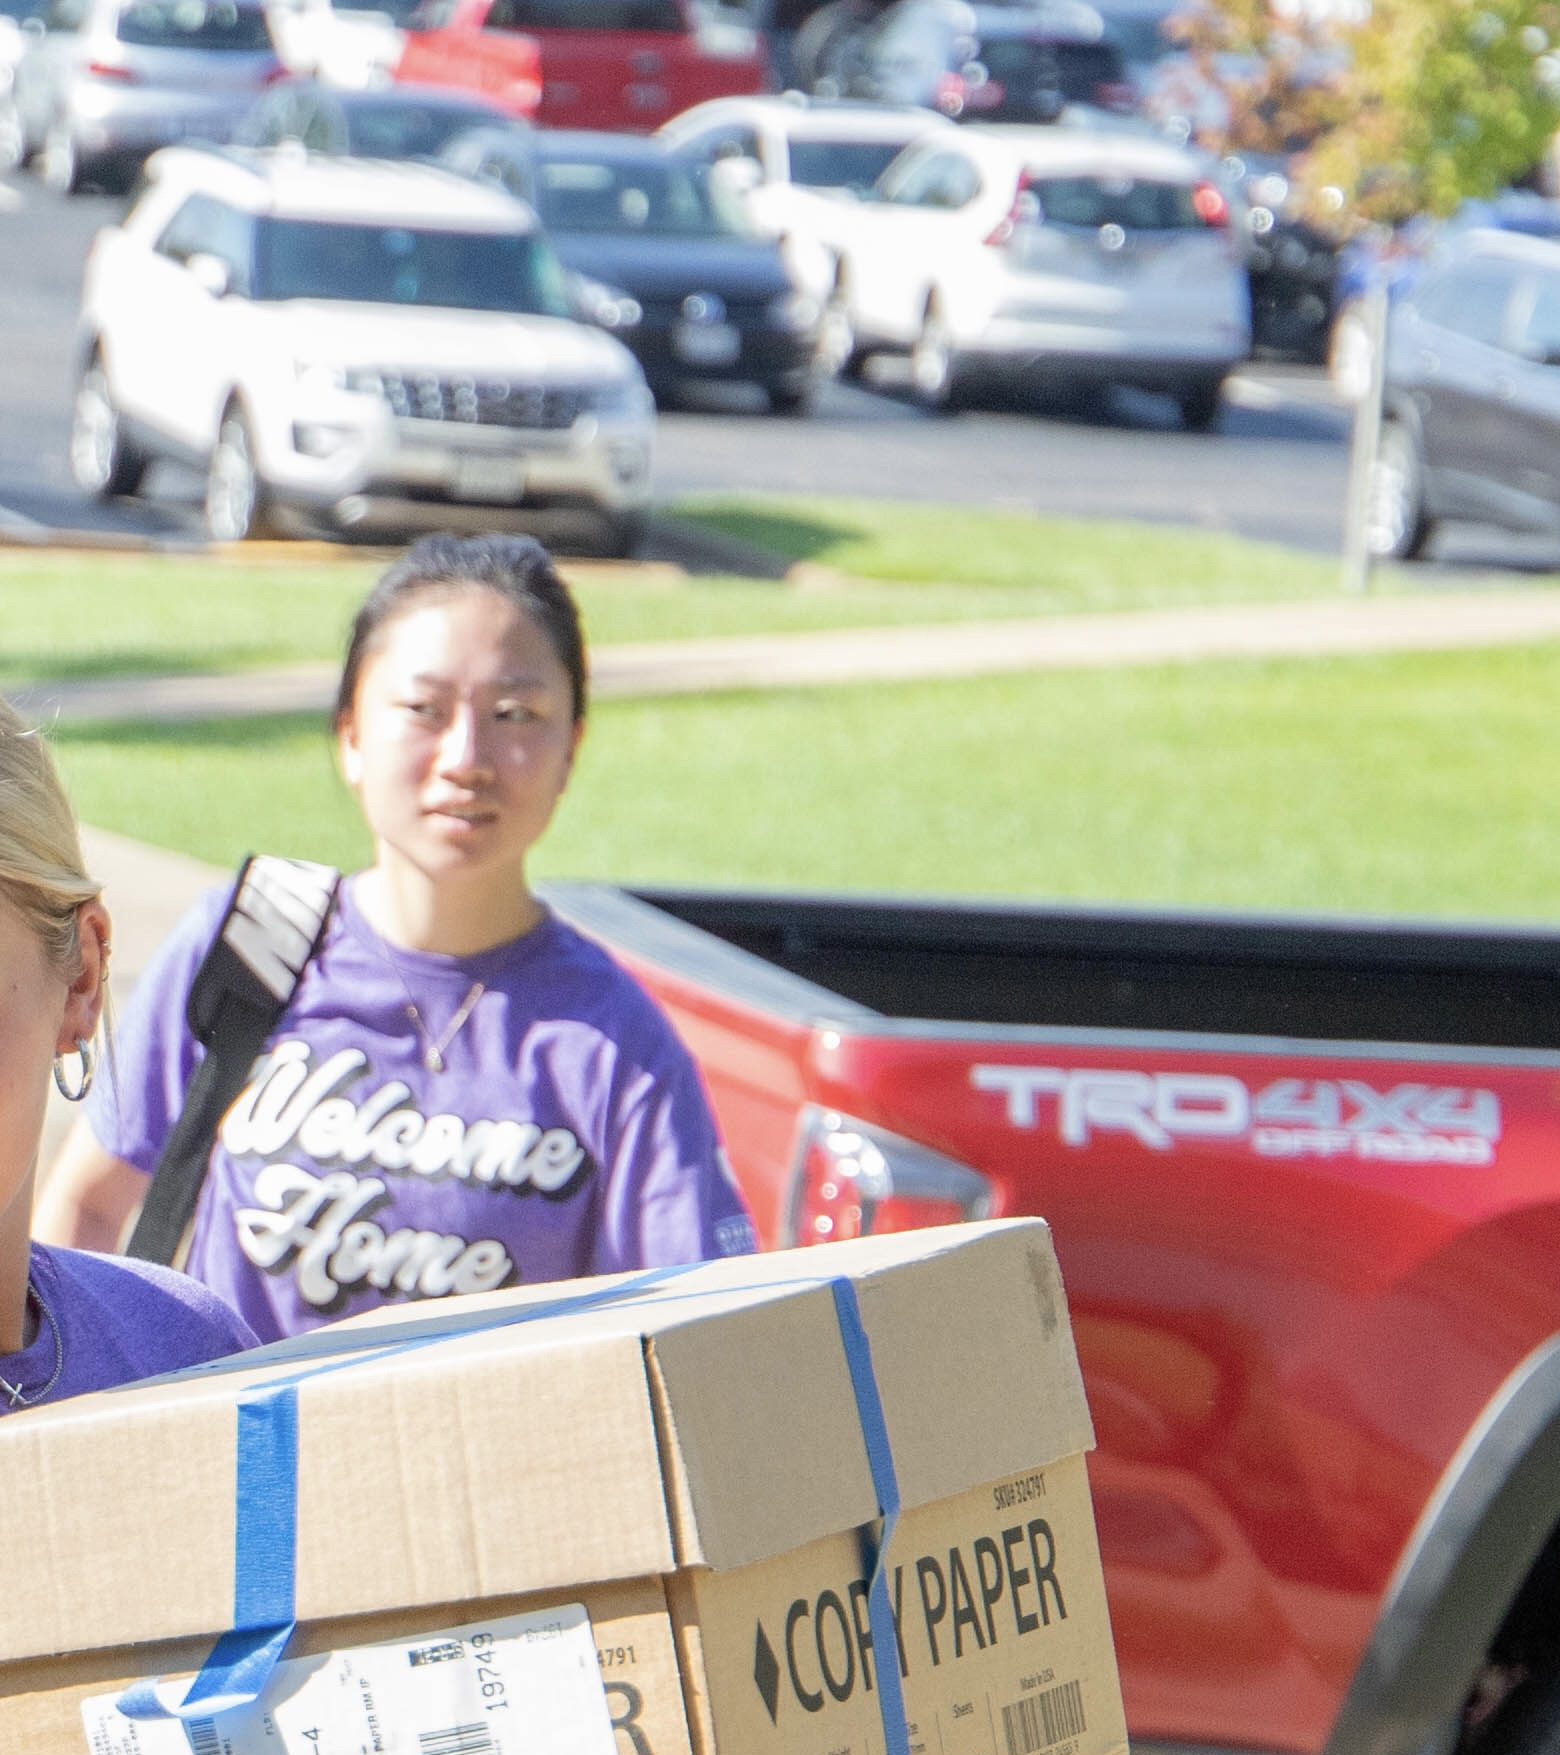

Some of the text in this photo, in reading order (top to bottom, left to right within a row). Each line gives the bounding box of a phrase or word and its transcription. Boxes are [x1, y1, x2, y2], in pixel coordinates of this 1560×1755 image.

[221, 1039, 584, 1190] Welcome
[970, 1064, 1250, 1150] TRD
[236, 1164, 514, 1305] Home
[916, 1517, 1068, 1667] PAPER
[470, 1631, 508, 1711] 19749
[594, 1643, 638, 1667] 4791
[366, 1714, 386, 1752] PAPER
